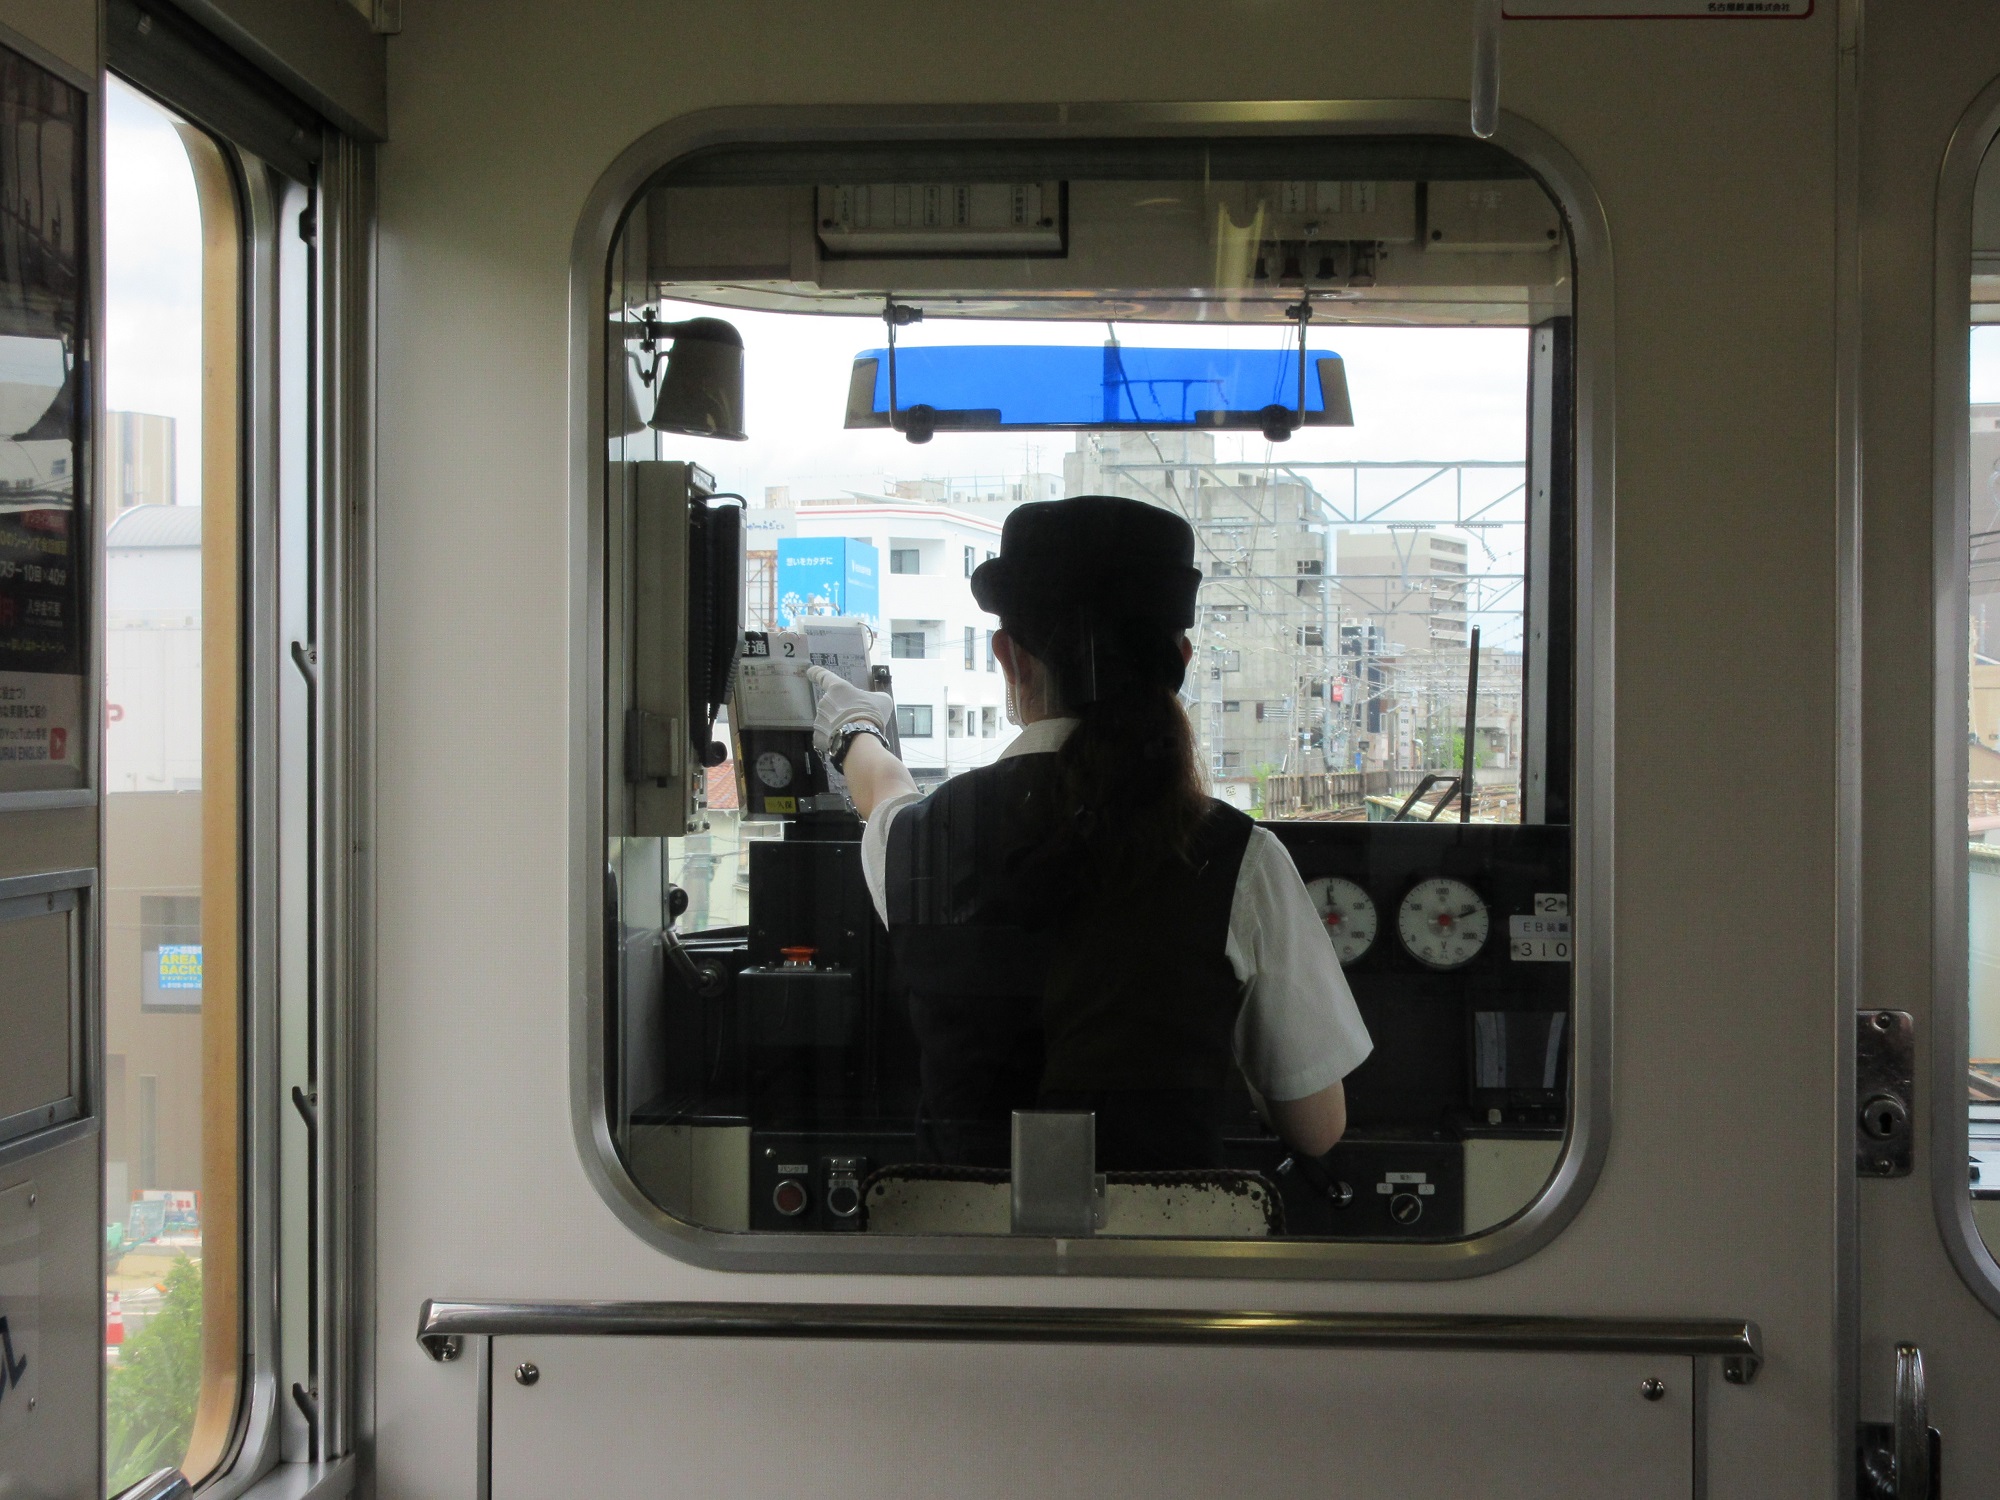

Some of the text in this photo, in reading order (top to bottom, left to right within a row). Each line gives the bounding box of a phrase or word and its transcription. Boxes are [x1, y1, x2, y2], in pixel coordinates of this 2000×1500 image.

[1708, 3, 1790, 12] 名古屋鉄道株式会社
[786, 557, 833, 567] 想いをカタチに
[783, 642, 796, 658] 2
[811, 654, 838, 666] 普通
[1353, 902, 1365, 910] 500
[1410, 903, 1422, 911] 500
[1544, 897, 1558, 912] 2
[1521, 942, 1568, 957] 310
[161, 954, 198, 965] AREA
